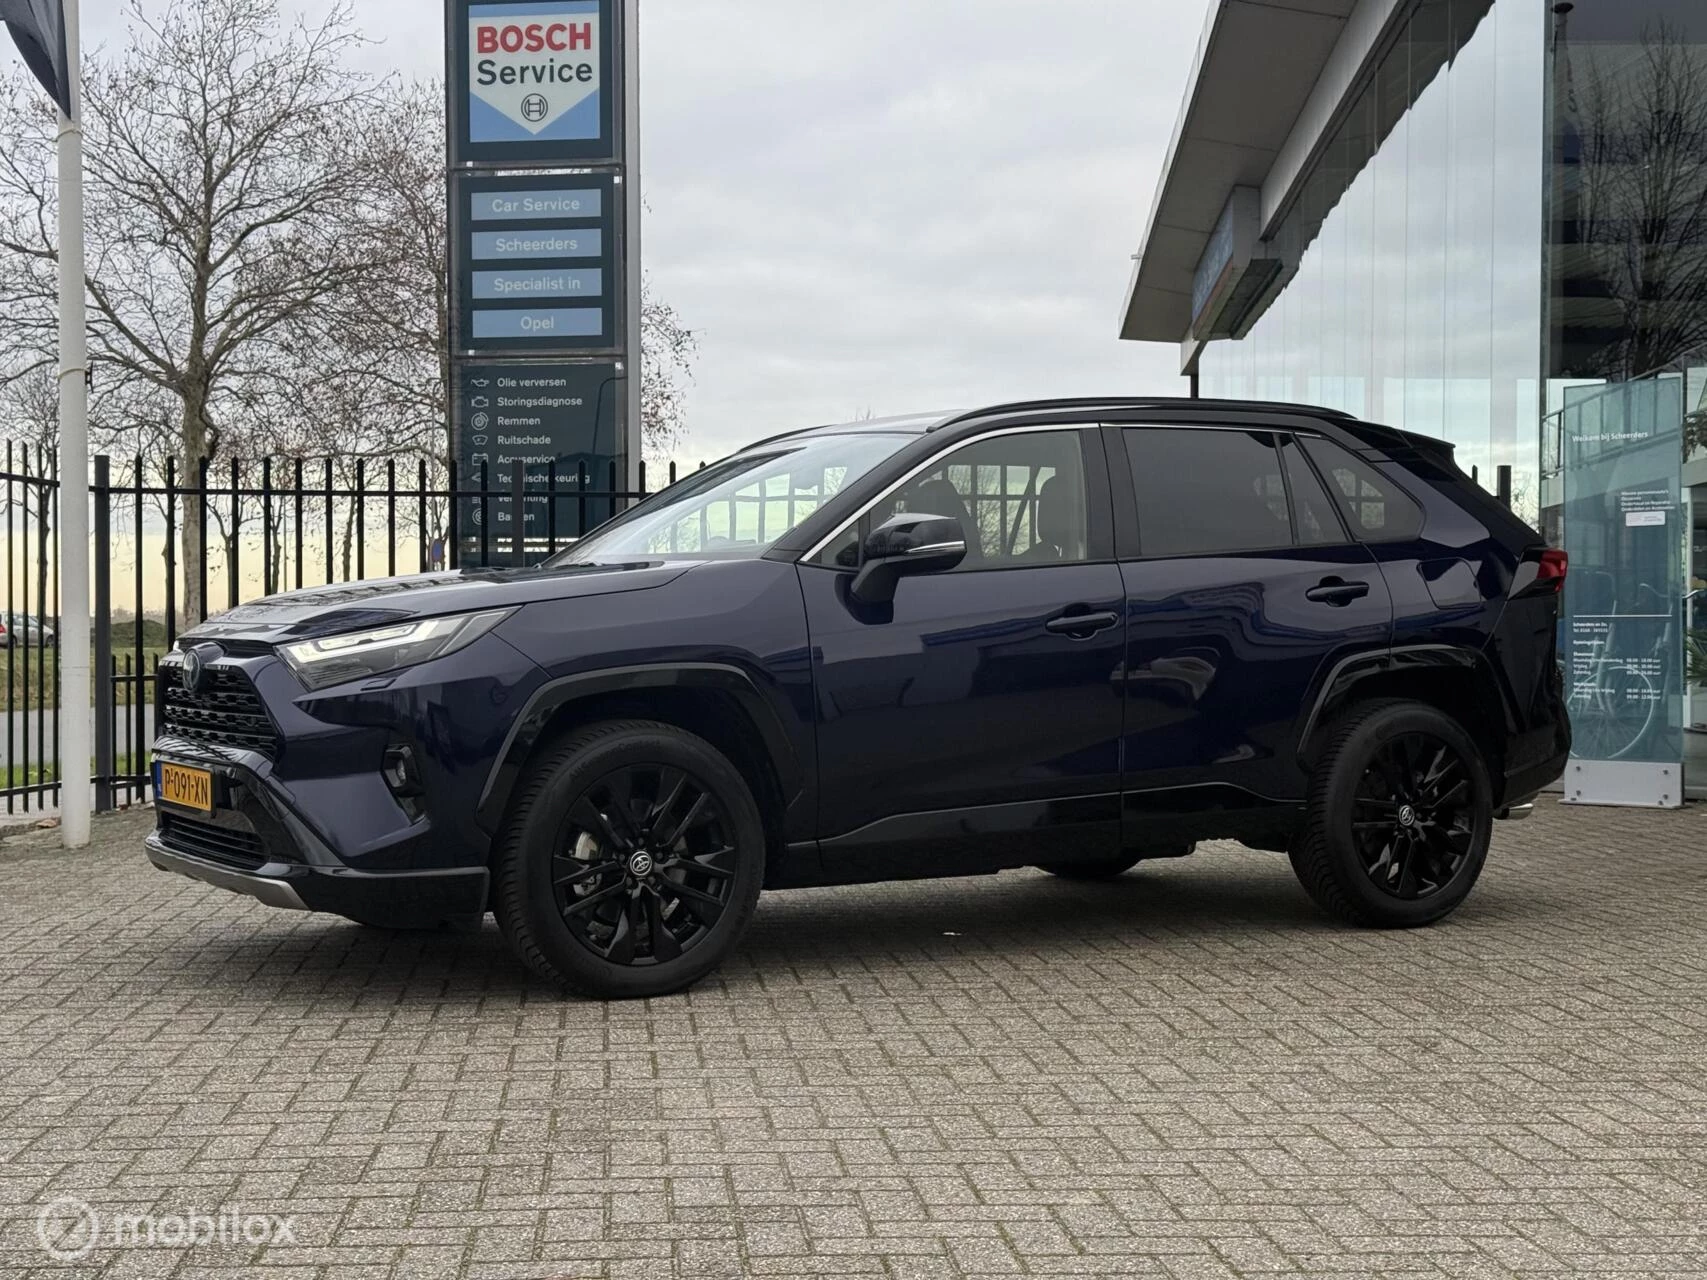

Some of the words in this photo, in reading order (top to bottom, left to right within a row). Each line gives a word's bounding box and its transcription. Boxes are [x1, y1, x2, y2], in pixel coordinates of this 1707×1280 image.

[477, 22, 592, 54] BOSCH
[477, 58, 593, 86] Service
[491, 199, 519, 213] Car
[523, 197, 581, 212] Service
[495, 237, 578, 253] Scheerders
[494, 276, 564, 293] Specialist
[567, 276, 581, 290] in
[520, 315, 555, 331] Opel
[497, 377, 517, 387] Olie
[519, 377, 567, 387] verversen
[497, 396, 583, 408] Storingsdiagnose
[497, 416, 541, 426] Remmen
[497, 435, 551, 445] Ruitschade
[497, 472, 550, 483] Tecische
[553, 472, 591, 485] keurig
[497, 511, 535, 522] Baen
[164, 767, 208, 806] P-091-XN
